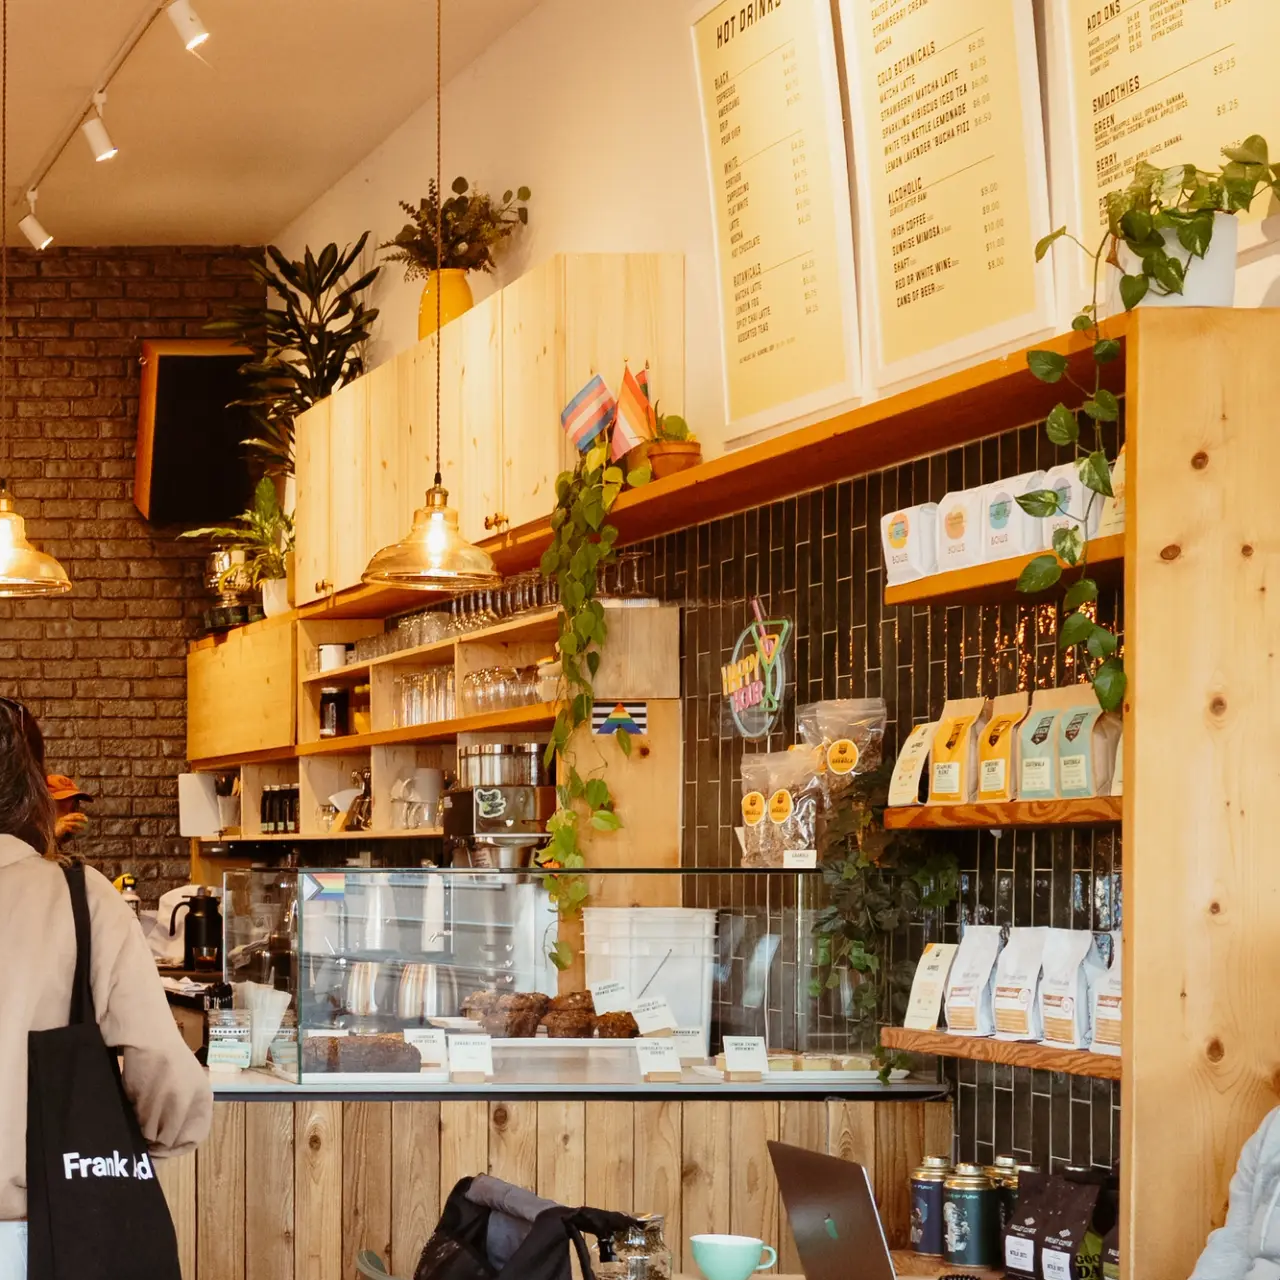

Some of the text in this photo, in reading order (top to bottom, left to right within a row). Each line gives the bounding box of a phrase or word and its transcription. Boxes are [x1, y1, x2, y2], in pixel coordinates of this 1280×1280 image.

[717, 15, 735, 49] HOT
[873, 7, 906, 38] STRAWBERRY
[1087, 0, 1121, 32] ADD ONS
[715, 70, 729, 90] BLACK
[877, 40, 935, 87] COLD BOTANICALS
[879, 84, 899, 104] MATCHA
[900, 74, 916, 91] LATTE
[880, 94, 914, 122] STRAWBERRY
[915, 79, 939, 101] MATCHA
[940, 68, 959, 87] LATTE
[1092, 75, 1140, 113] SMOOTHIES
[882, 114, 910, 139] SPARKLING
[911, 98, 938, 122] HIBISCUS
[939, 90, 954, 107] ICED
[955, 83, 967, 97] TEA
[1094, 113, 1115, 134] GREEN
[884, 138, 900, 156] WHITE
[900, 133, 910, 146] TEA
[911, 121, 932, 140] NETTLE
[932, 102, 967, 129] LEMONADE
[1096, 98, 1239, 172] BERRY $9.25
[885, 156, 903, 174] LEMON
[904, 140, 932, 163] LAVENDER
[956, 120, 970, 136] FIZZ
[888, 176, 922, 205] ALCOHOLIC
[890, 226, 905, 240] IRISH
[906, 212, 926, 232] COFFEE
[892, 236, 916, 257] SUNRISE
[916, 225, 940, 245] MIMOSA
[982, 200, 1000, 216] $9.00
[893, 257, 910, 274] SHAFT
[984, 218, 1005, 234] $10.00
[733, 262, 761, 288] BOTANICALS
[895, 277, 906, 291] RED
[915, 264, 935, 282] WHITE
[935, 257, 952, 273] WINE
[986, 236, 1005, 252] $11.00
[897, 293, 911, 308] CANS
[920, 282, 936, 299] BEER
[721, 651, 760, 696] HAPPY
[733, 680, 764, 713] HOUR
[62, 1150, 130, 1180] Frank
